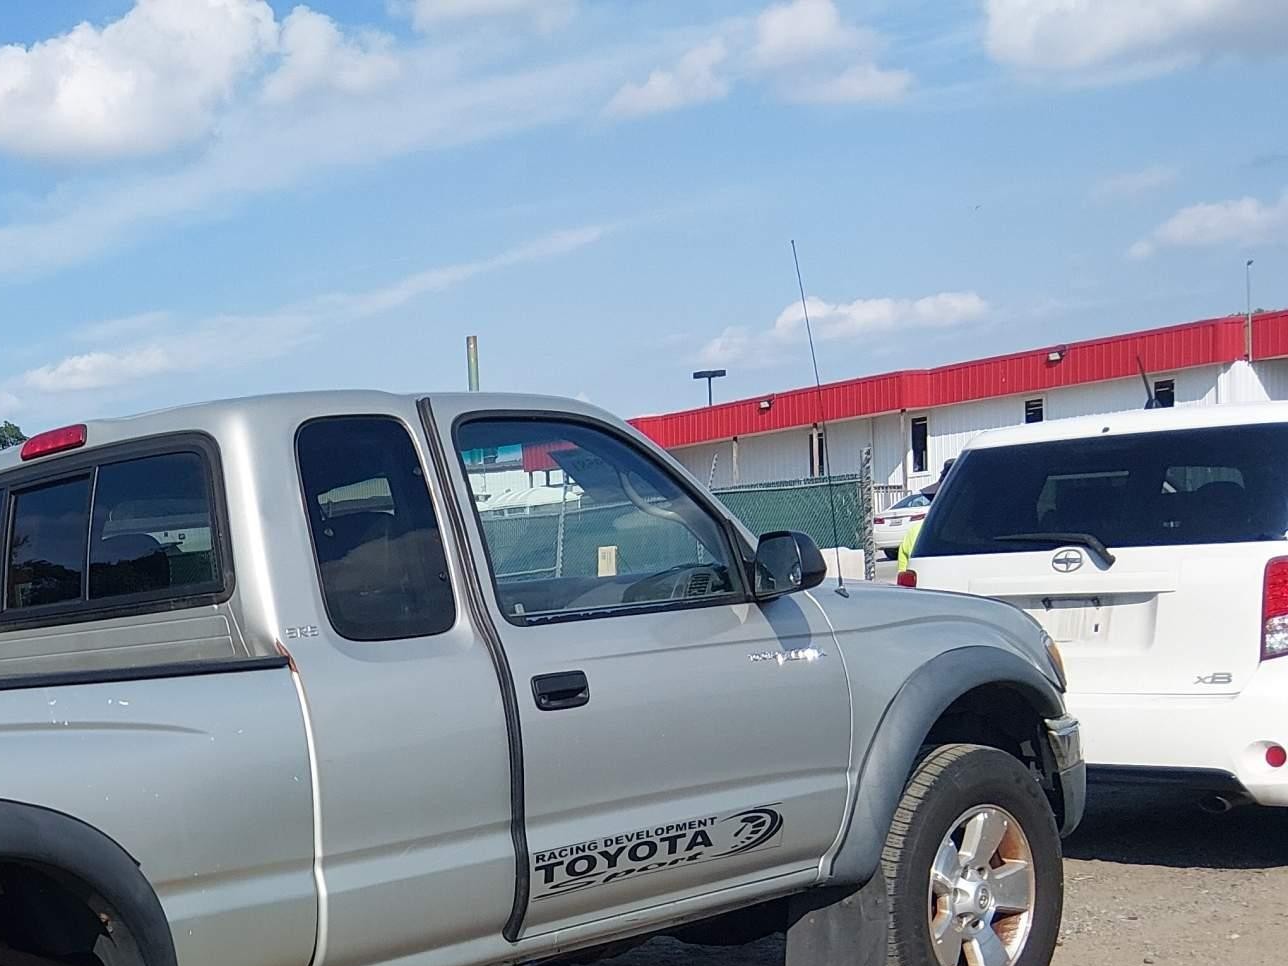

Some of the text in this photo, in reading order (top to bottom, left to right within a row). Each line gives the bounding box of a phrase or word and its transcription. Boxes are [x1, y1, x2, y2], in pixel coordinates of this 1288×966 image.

[535, 816, 718, 864] RACING DEVELOPMENT
[535, 829, 714, 884] TOYOTA
[533, 851, 704, 899] Sport
